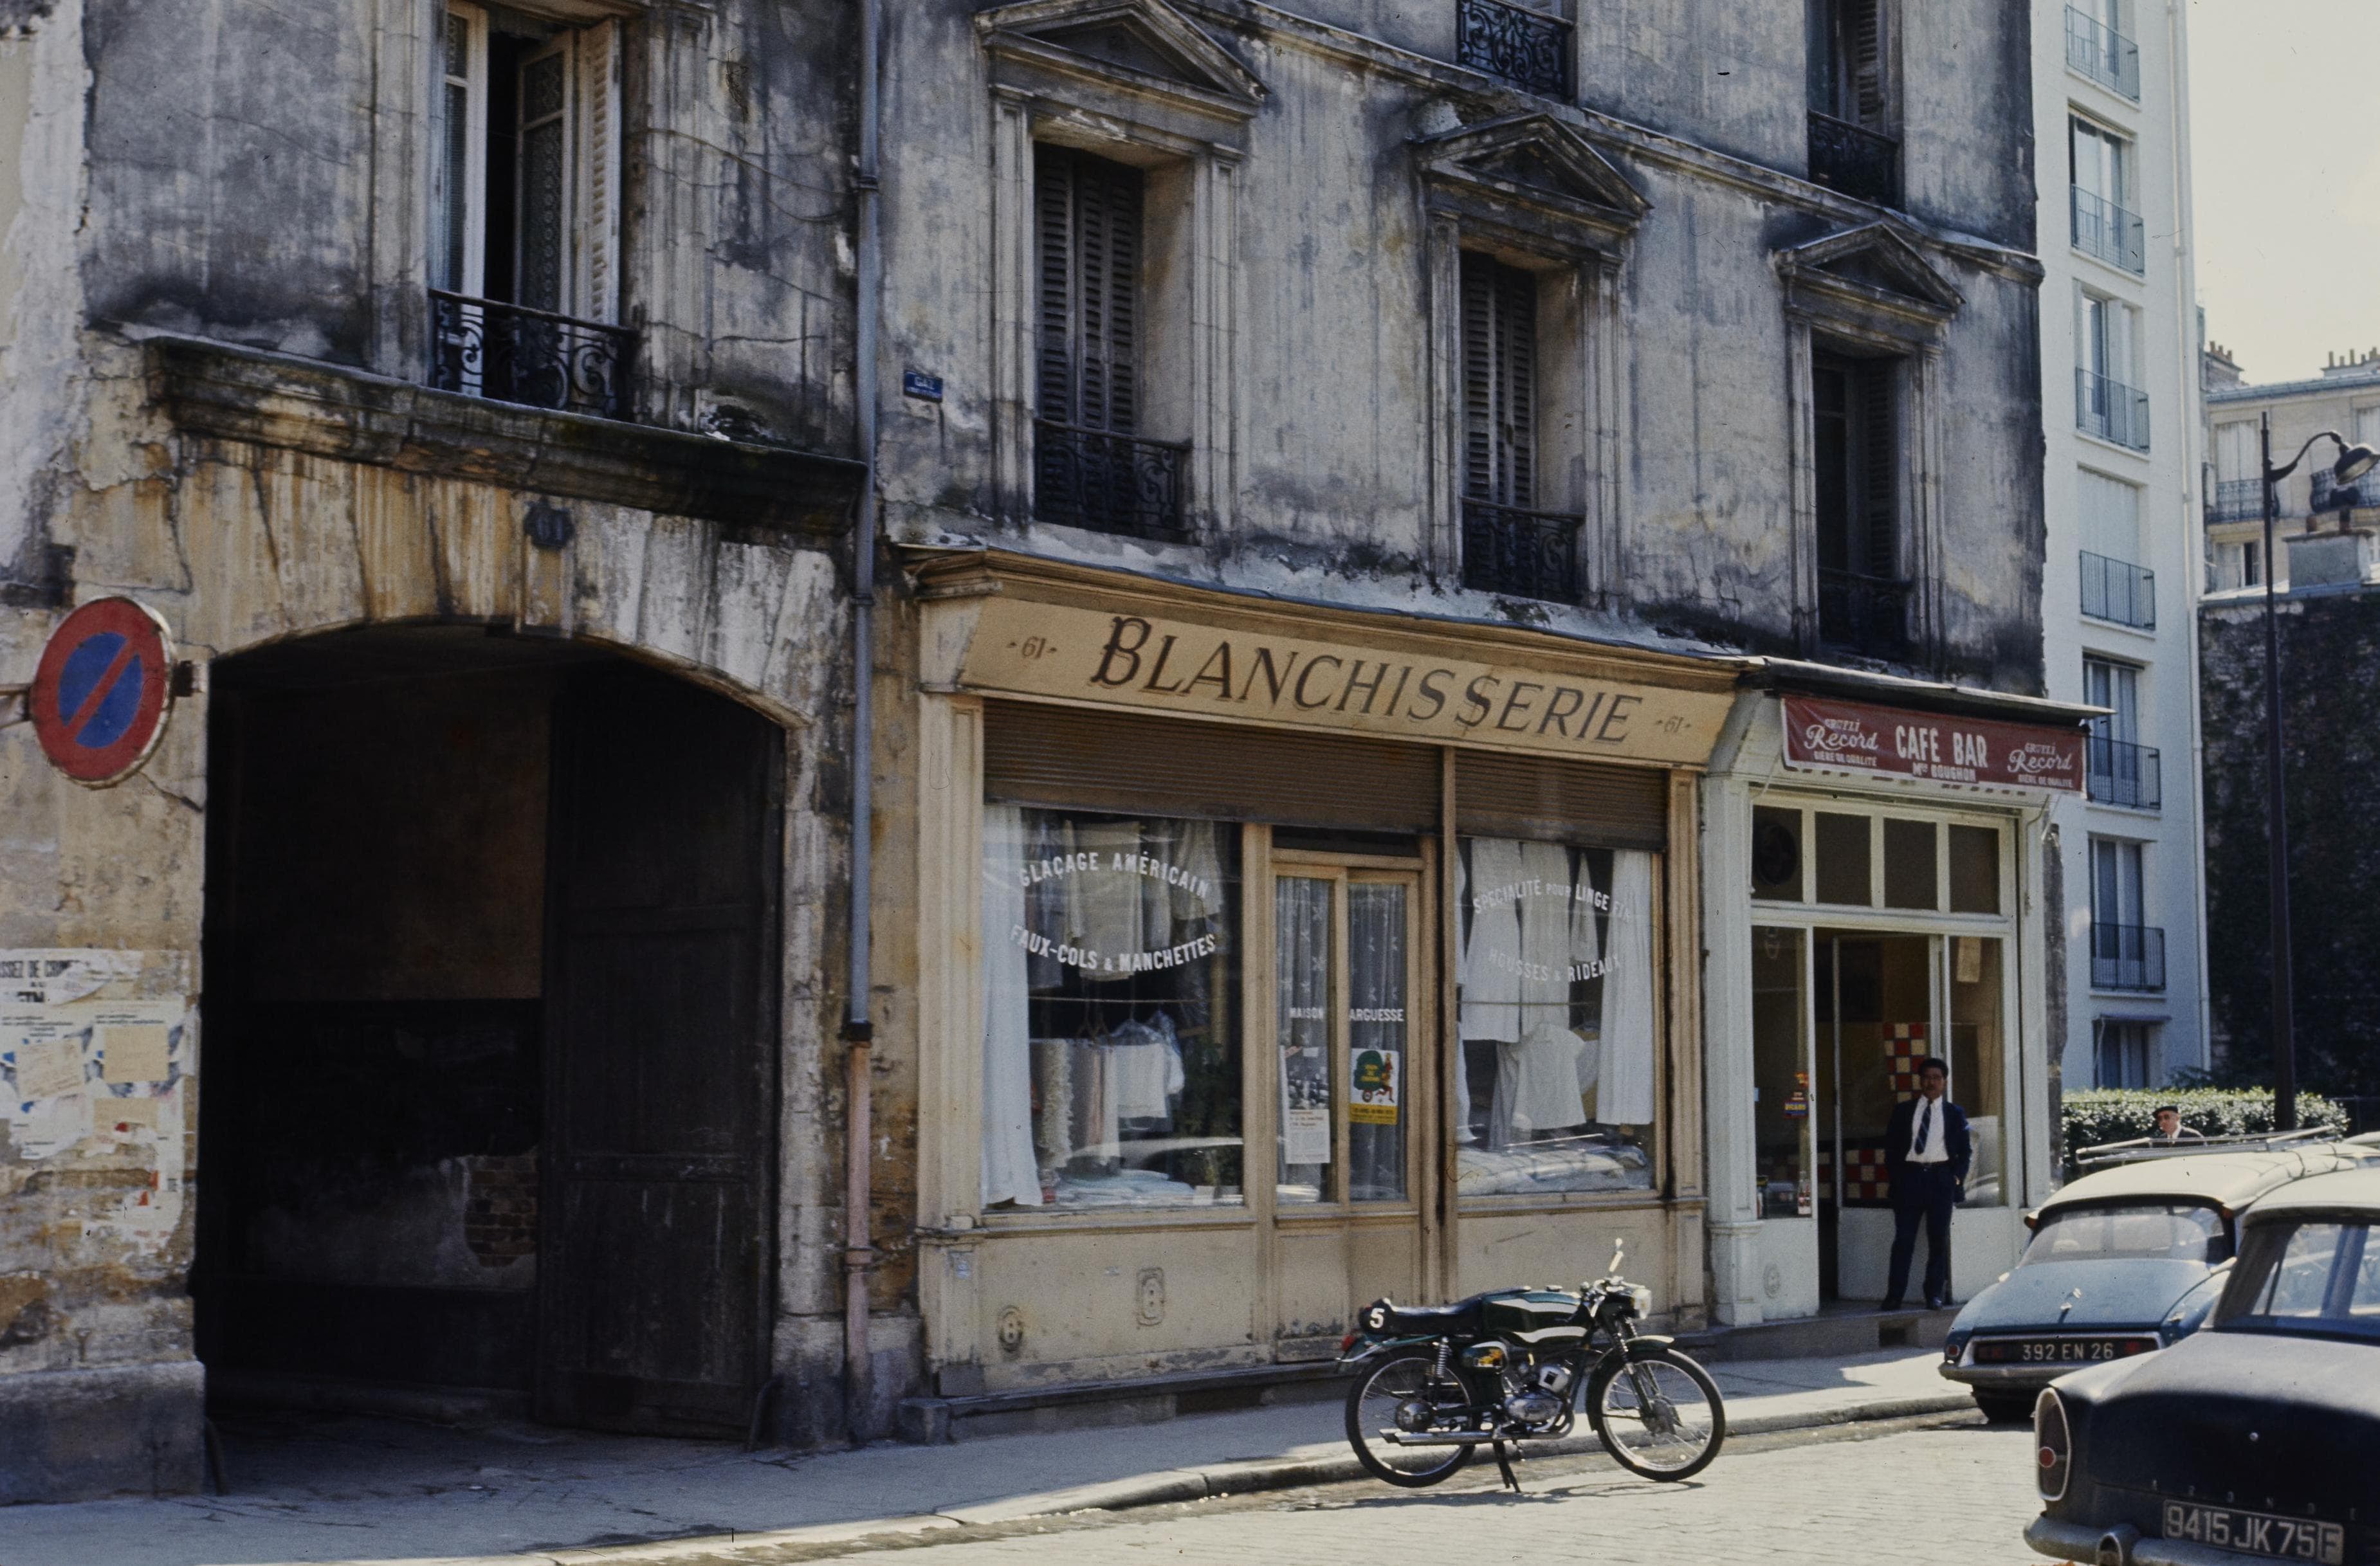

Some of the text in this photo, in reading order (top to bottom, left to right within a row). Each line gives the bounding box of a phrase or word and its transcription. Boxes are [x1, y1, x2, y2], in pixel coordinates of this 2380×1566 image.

[1022, 636, 1046, 659] 61
[1089, 615, 1644, 743] BLANCHISSERIE
[1804, 724, 1879, 751] Record
[1952, 731, 1989, 769] BAR
[2007, 749, 2074, 773] Record
[1019, 851, 1209, 898] GLAÇAGE AMÉRICAIN
[1576, 883, 1610, 911] LINGE
[1010, 924, 1098, 970] FAUX-COLS
[1119, 933, 1216, 972] MANCHETTES
[1568, 952, 1620, 983] RIDEAUX
[1289, 1006, 1324, 1020] MAISON
[1369, 1307, 1385, 1329] 5
[2022, 1342, 2114, 1361] 392 EN 26
[2166, 1506, 2230, 1545] 9415
[2233, 1515, 2271, 1552] JK
